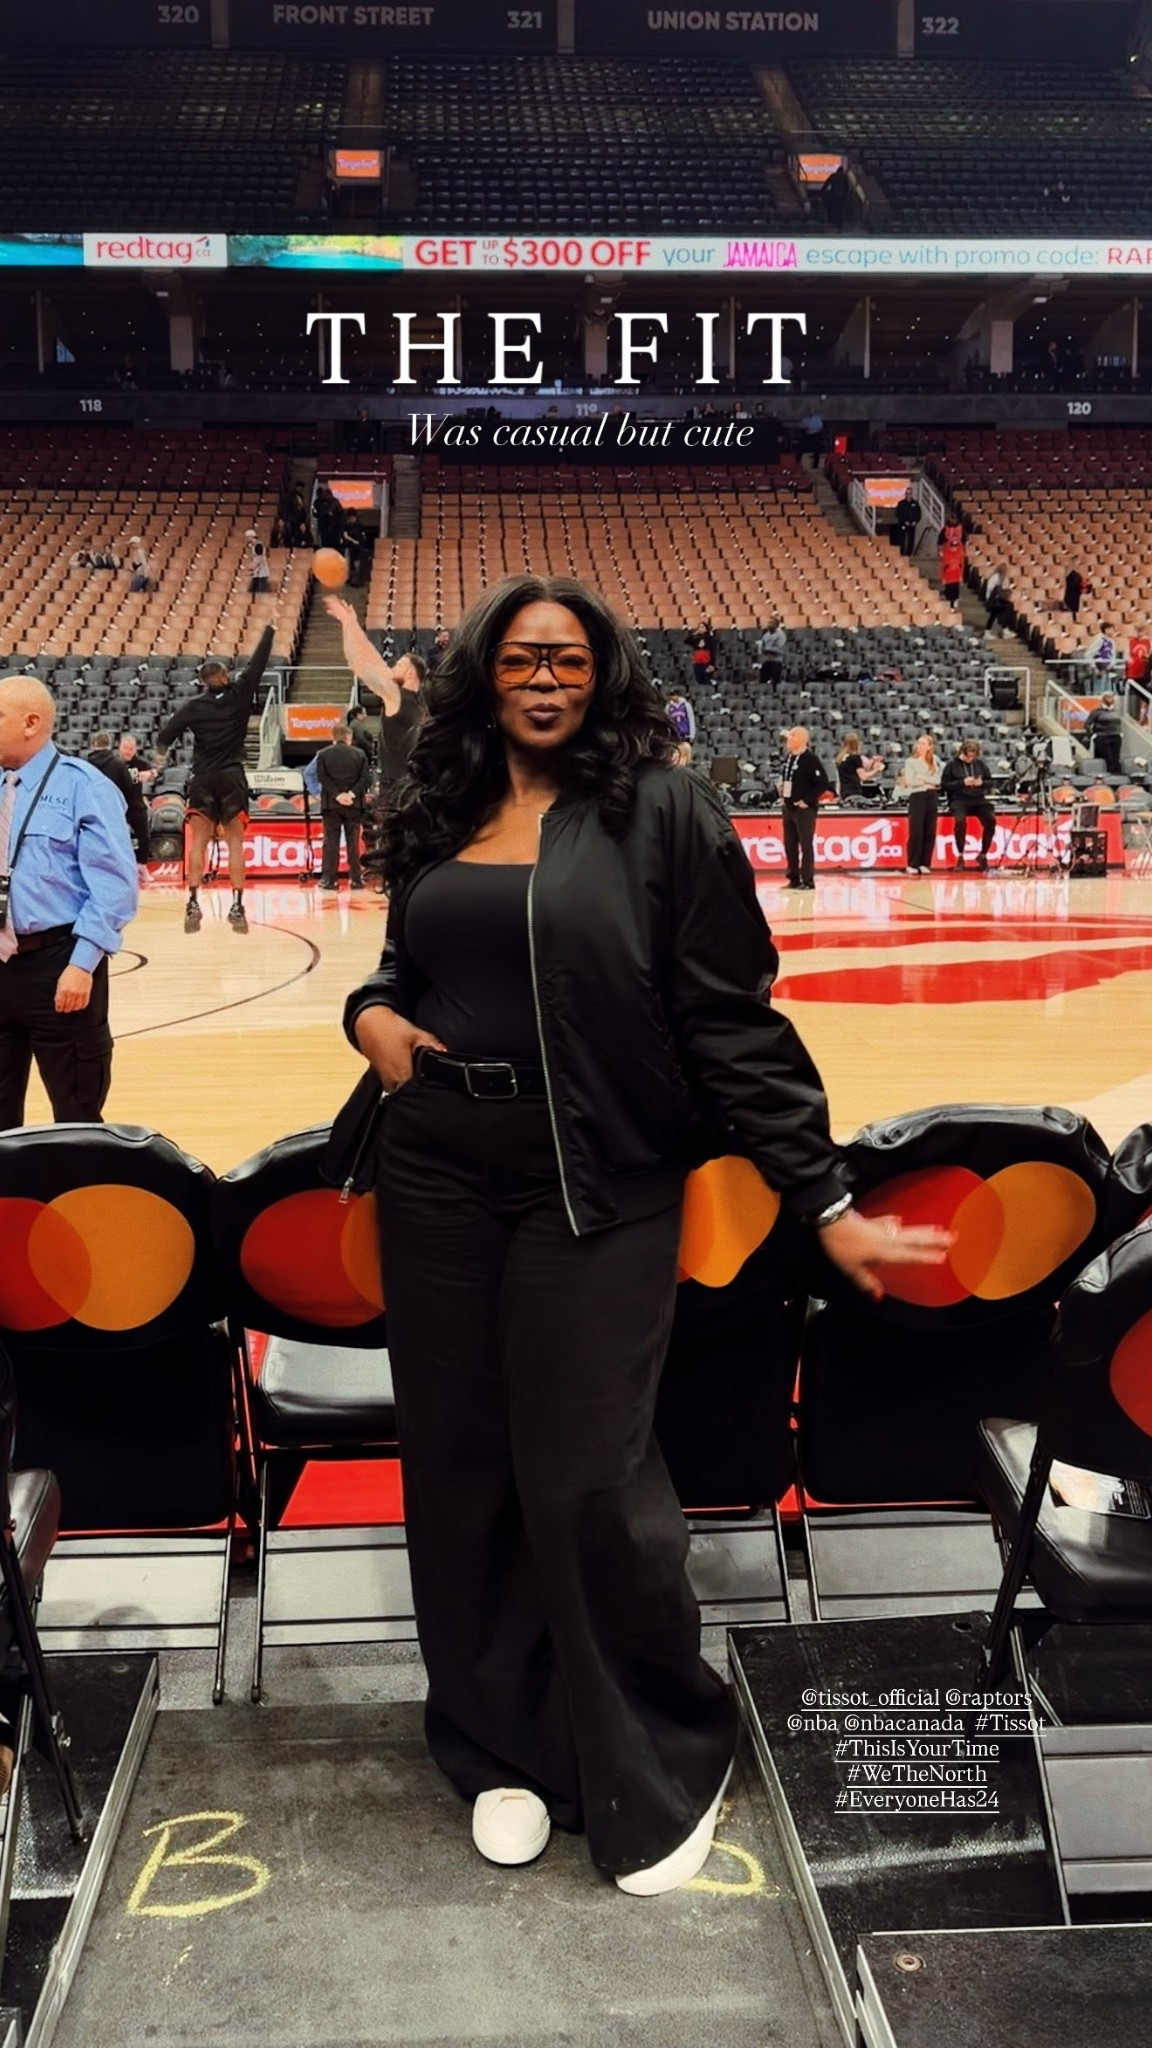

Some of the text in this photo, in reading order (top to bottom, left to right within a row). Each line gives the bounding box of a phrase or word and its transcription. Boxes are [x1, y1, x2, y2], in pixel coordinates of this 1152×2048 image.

[157, 4, 200, 24] 320
[273, 4, 435, 26] FRONT STREET
[507, 10, 543, 29] 321
[647, 10, 820, 32] UNION STATION
[922, 16, 960, 34] 322
[414, 240, 476, 266] GET
[482, 240, 499, 250] UP
[504, 238, 583, 268] $300
[590, 240, 650, 267] OFF
[899, 245, 948, 265] with
[483, 254, 500, 265] TO
[662, 248, 716, 267] your
[723, 242, 798, 269] JAMAICA
[806, 248, 892, 269] escape
[955, 249, 1031, 269] promo
[1036, 246, 1099, 265] code:
[79, 399, 103, 412] 118
[1067, 401, 1092, 415] 120
[126, 1810, 272, 1918] B
